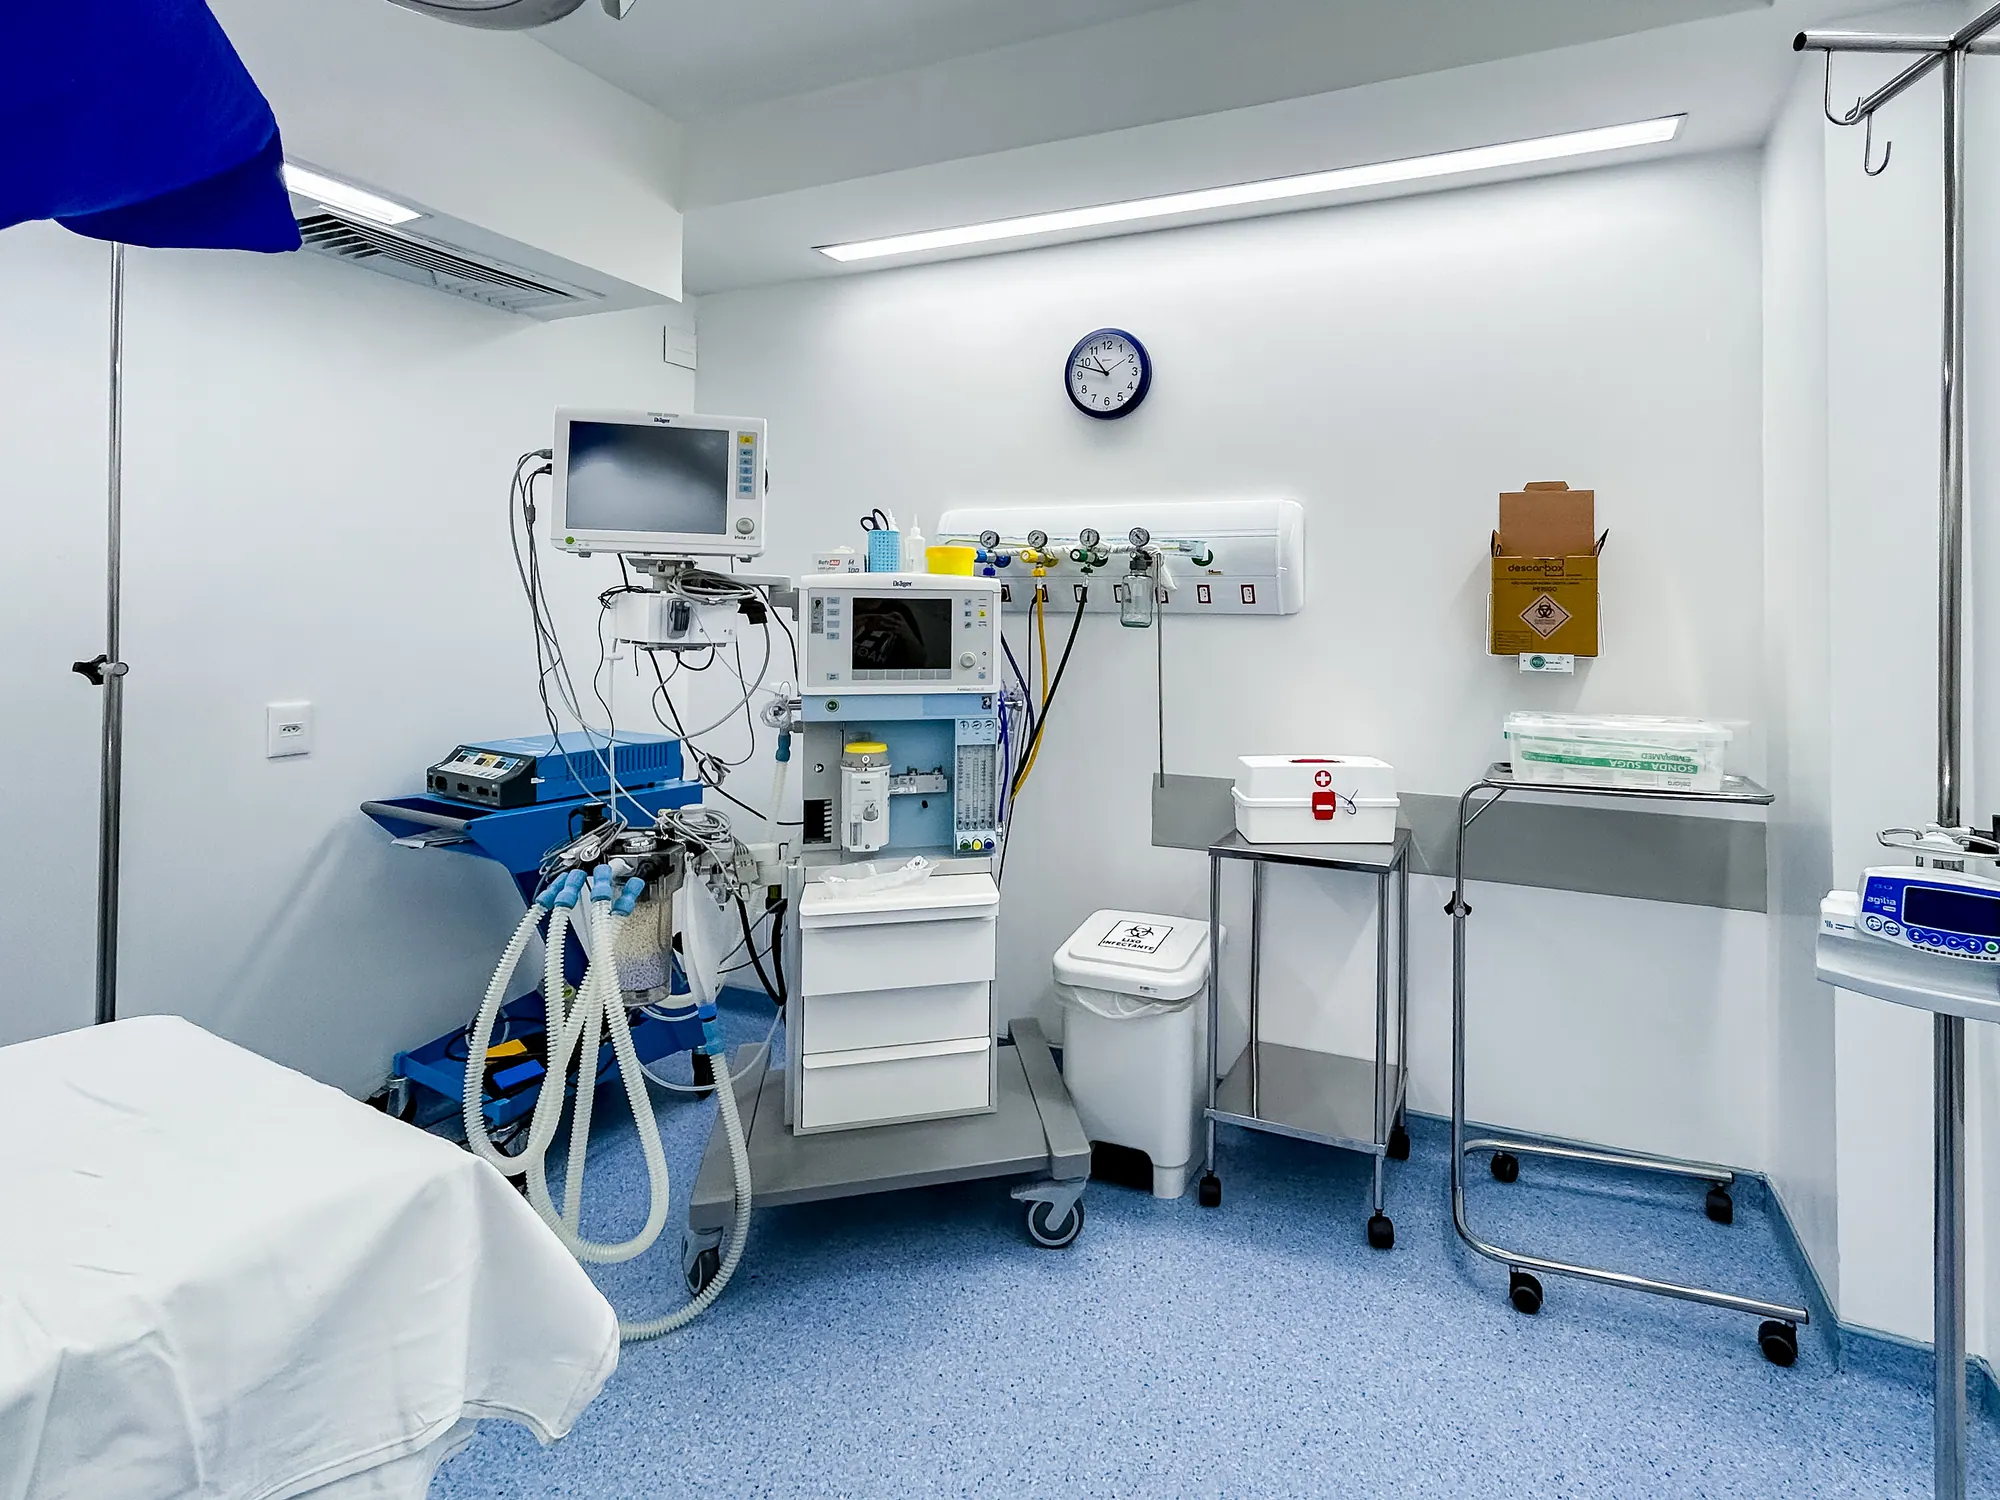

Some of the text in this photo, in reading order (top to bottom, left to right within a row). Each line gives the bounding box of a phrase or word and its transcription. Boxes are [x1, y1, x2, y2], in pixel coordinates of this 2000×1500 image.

[1102, 341, 1113, 350] 12
[1119, 344, 1123, 353] 1
[1089, 346, 1098, 355] 11
[1080, 358, 1091, 367] 10
[1128, 354, 1134, 363] 2
[1077, 371, 1083, 380] 9
[1131, 367, 1138, 376] 3
[1081, 385, 1087, 394] 8
[1127, 382, 1134, 390] 4
[1091, 394, 1097, 403] 7
[1117, 392, 1123, 401] 5
[1104, 397, 1110, 406] 6
[1508, 561, 1564, 572] descarbox
[1609, 760, 1641, 769] SUGA
[1651, 763, 1694, 773] SONDA
[1867, 896, 1896, 905] agilia
[1102, 940, 1154, 950] INFECTANTE
